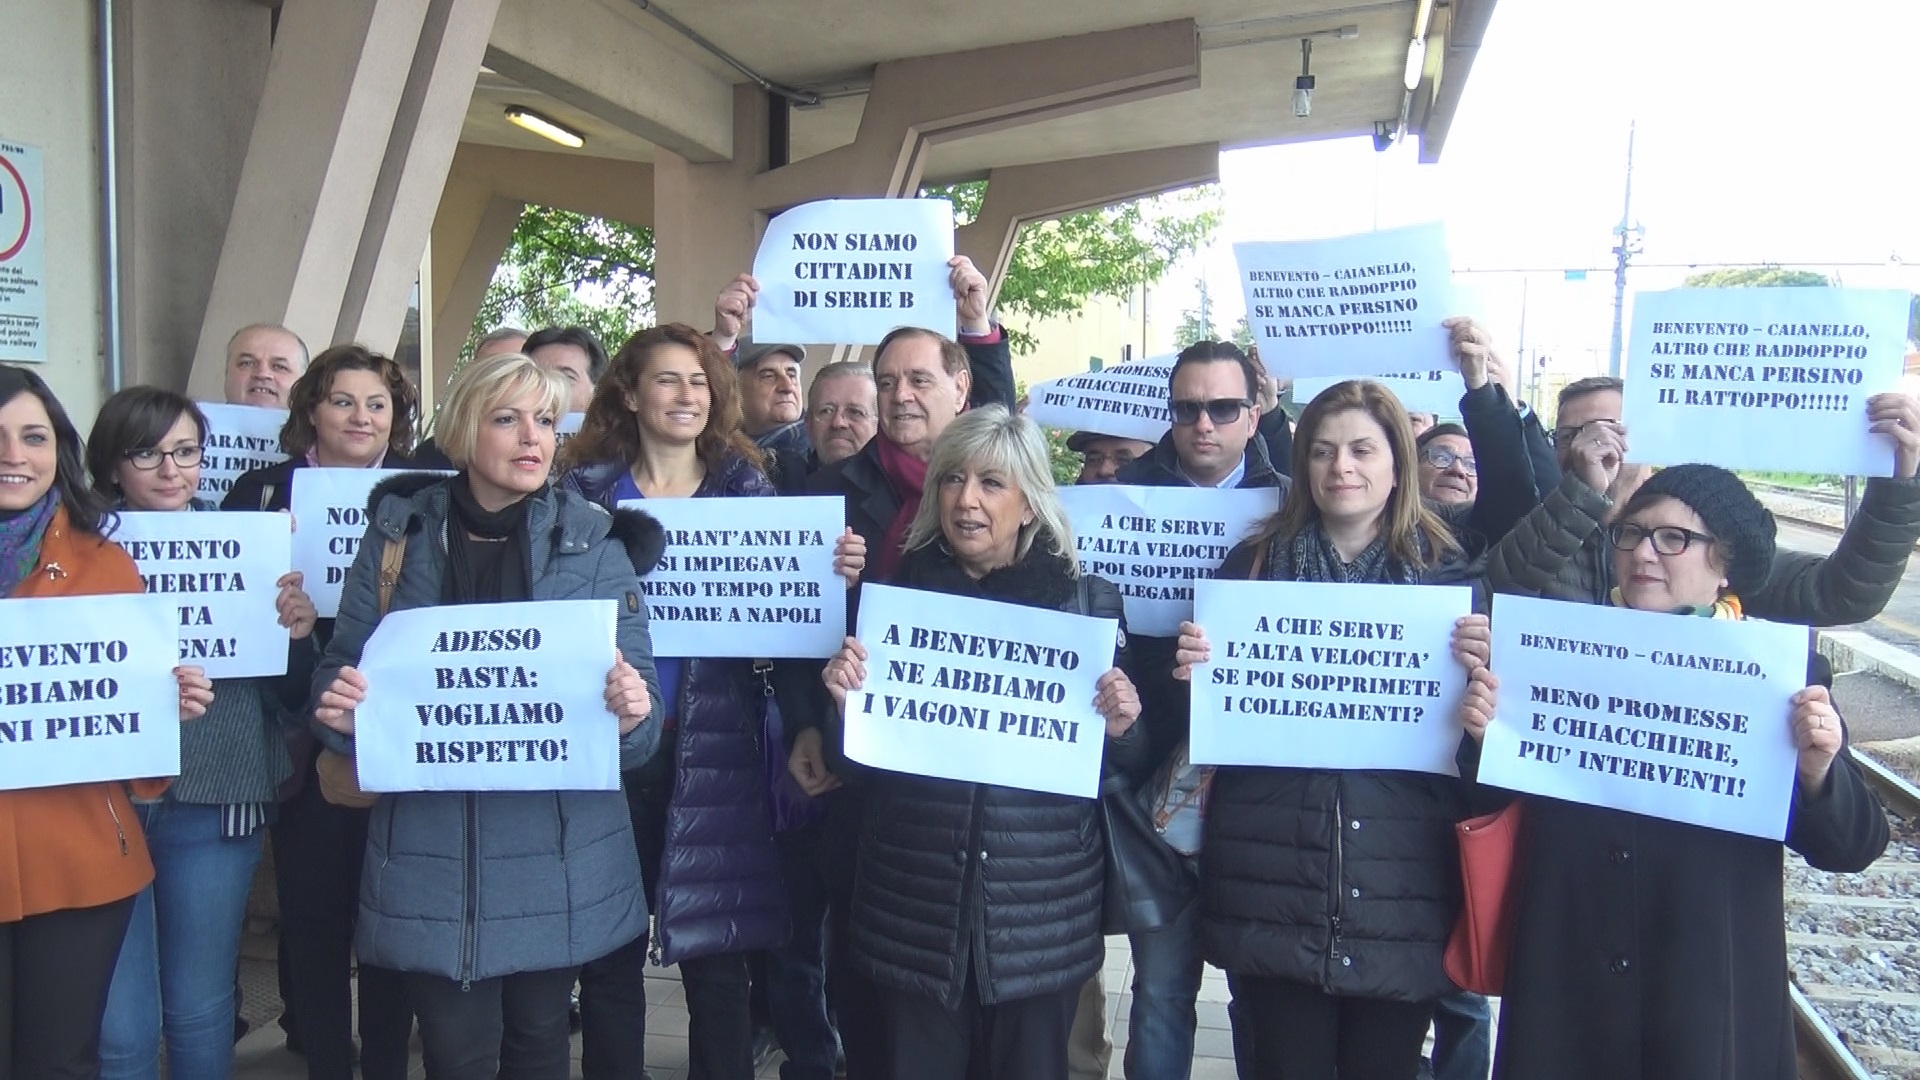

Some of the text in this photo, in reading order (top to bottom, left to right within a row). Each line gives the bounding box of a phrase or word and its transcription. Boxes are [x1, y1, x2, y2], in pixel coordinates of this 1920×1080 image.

[792, 233, 918, 251] NON SIAMO
[795, 262, 912, 280] CITTADINI
[1250, 271, 1319, 282] BENEVENTO
[1334, 262, 1416, 280] CAIANELLO,
[794, 291, 914, 308] DI SERIE B
[1253, 278, 1417, 298] ALTRO CHE RADDOPPIO
[1256, 298, 1418, 318] SE MANCA PERSINO
[1265, 320, 1412, 338] IL RATTOPPO!!!!!!
[1653, 322, 1748, 336] BENEVENTO
[1768, 324, 1870, 338] CAIANELLO,
[1651, 342, 1868, 359] ALTRO CHE RADDOPPIO
[1651, 364, 1862, 384] SE MANCA PERSINO
[1658, 389, 1848, 411] IL RATTOPPO!!!!!!
[1101, 514, 1226, 536] A CHE SERVE
[798, 530, 824, 546] FA
[1077, 536, 1228, 560] L'ALTA VELOCIT
[656, 556, 800, 572] SI IMPIEGAVA
[1093, 561, 1124, 576] POI
[639, 581, 820, 598] MENO TEMPO PER
[728, 607, 741, 622] A
[747, 607, 822, 624] NAPOLI
[431, 628, 542, 652] ADESSO
[1255, 616, 1404, 641] A CHE SERVE
[882, 624, 1079, 671] A BENEVENTO
[1226, 641, 1429, 668] L'ALTA VELOCITA'
[1520, 633, 1628, 660] BENEVENTO
[1650, 650, 1767, 680] CAIANELLO,
[435, 666, 538, 689] BASTA:
[888, 660, 1066, 704] NE ABBIAMO
[1212, 668, 1441, 698] SE POI SOPPRIMETE
[0, 678, 118, 706] BIAMO
[415, 702, 564, 726] VOGLIAMO
[862, 693, 1079, 743] I VAGONI PIENI
[1224, 696, 1424, 723] I COLLEGAMENTI?
[1530, 685, 1749, 734] MENO PROMESSE
[45, 712, 140, 740] PIENI
[1532, 712, 1738, 767] E CHIACCHIERE,
[416, 739, 568, 764] RISPETTO!
[1518, 741, 1746, 798] PIU' INTERVENTI!
